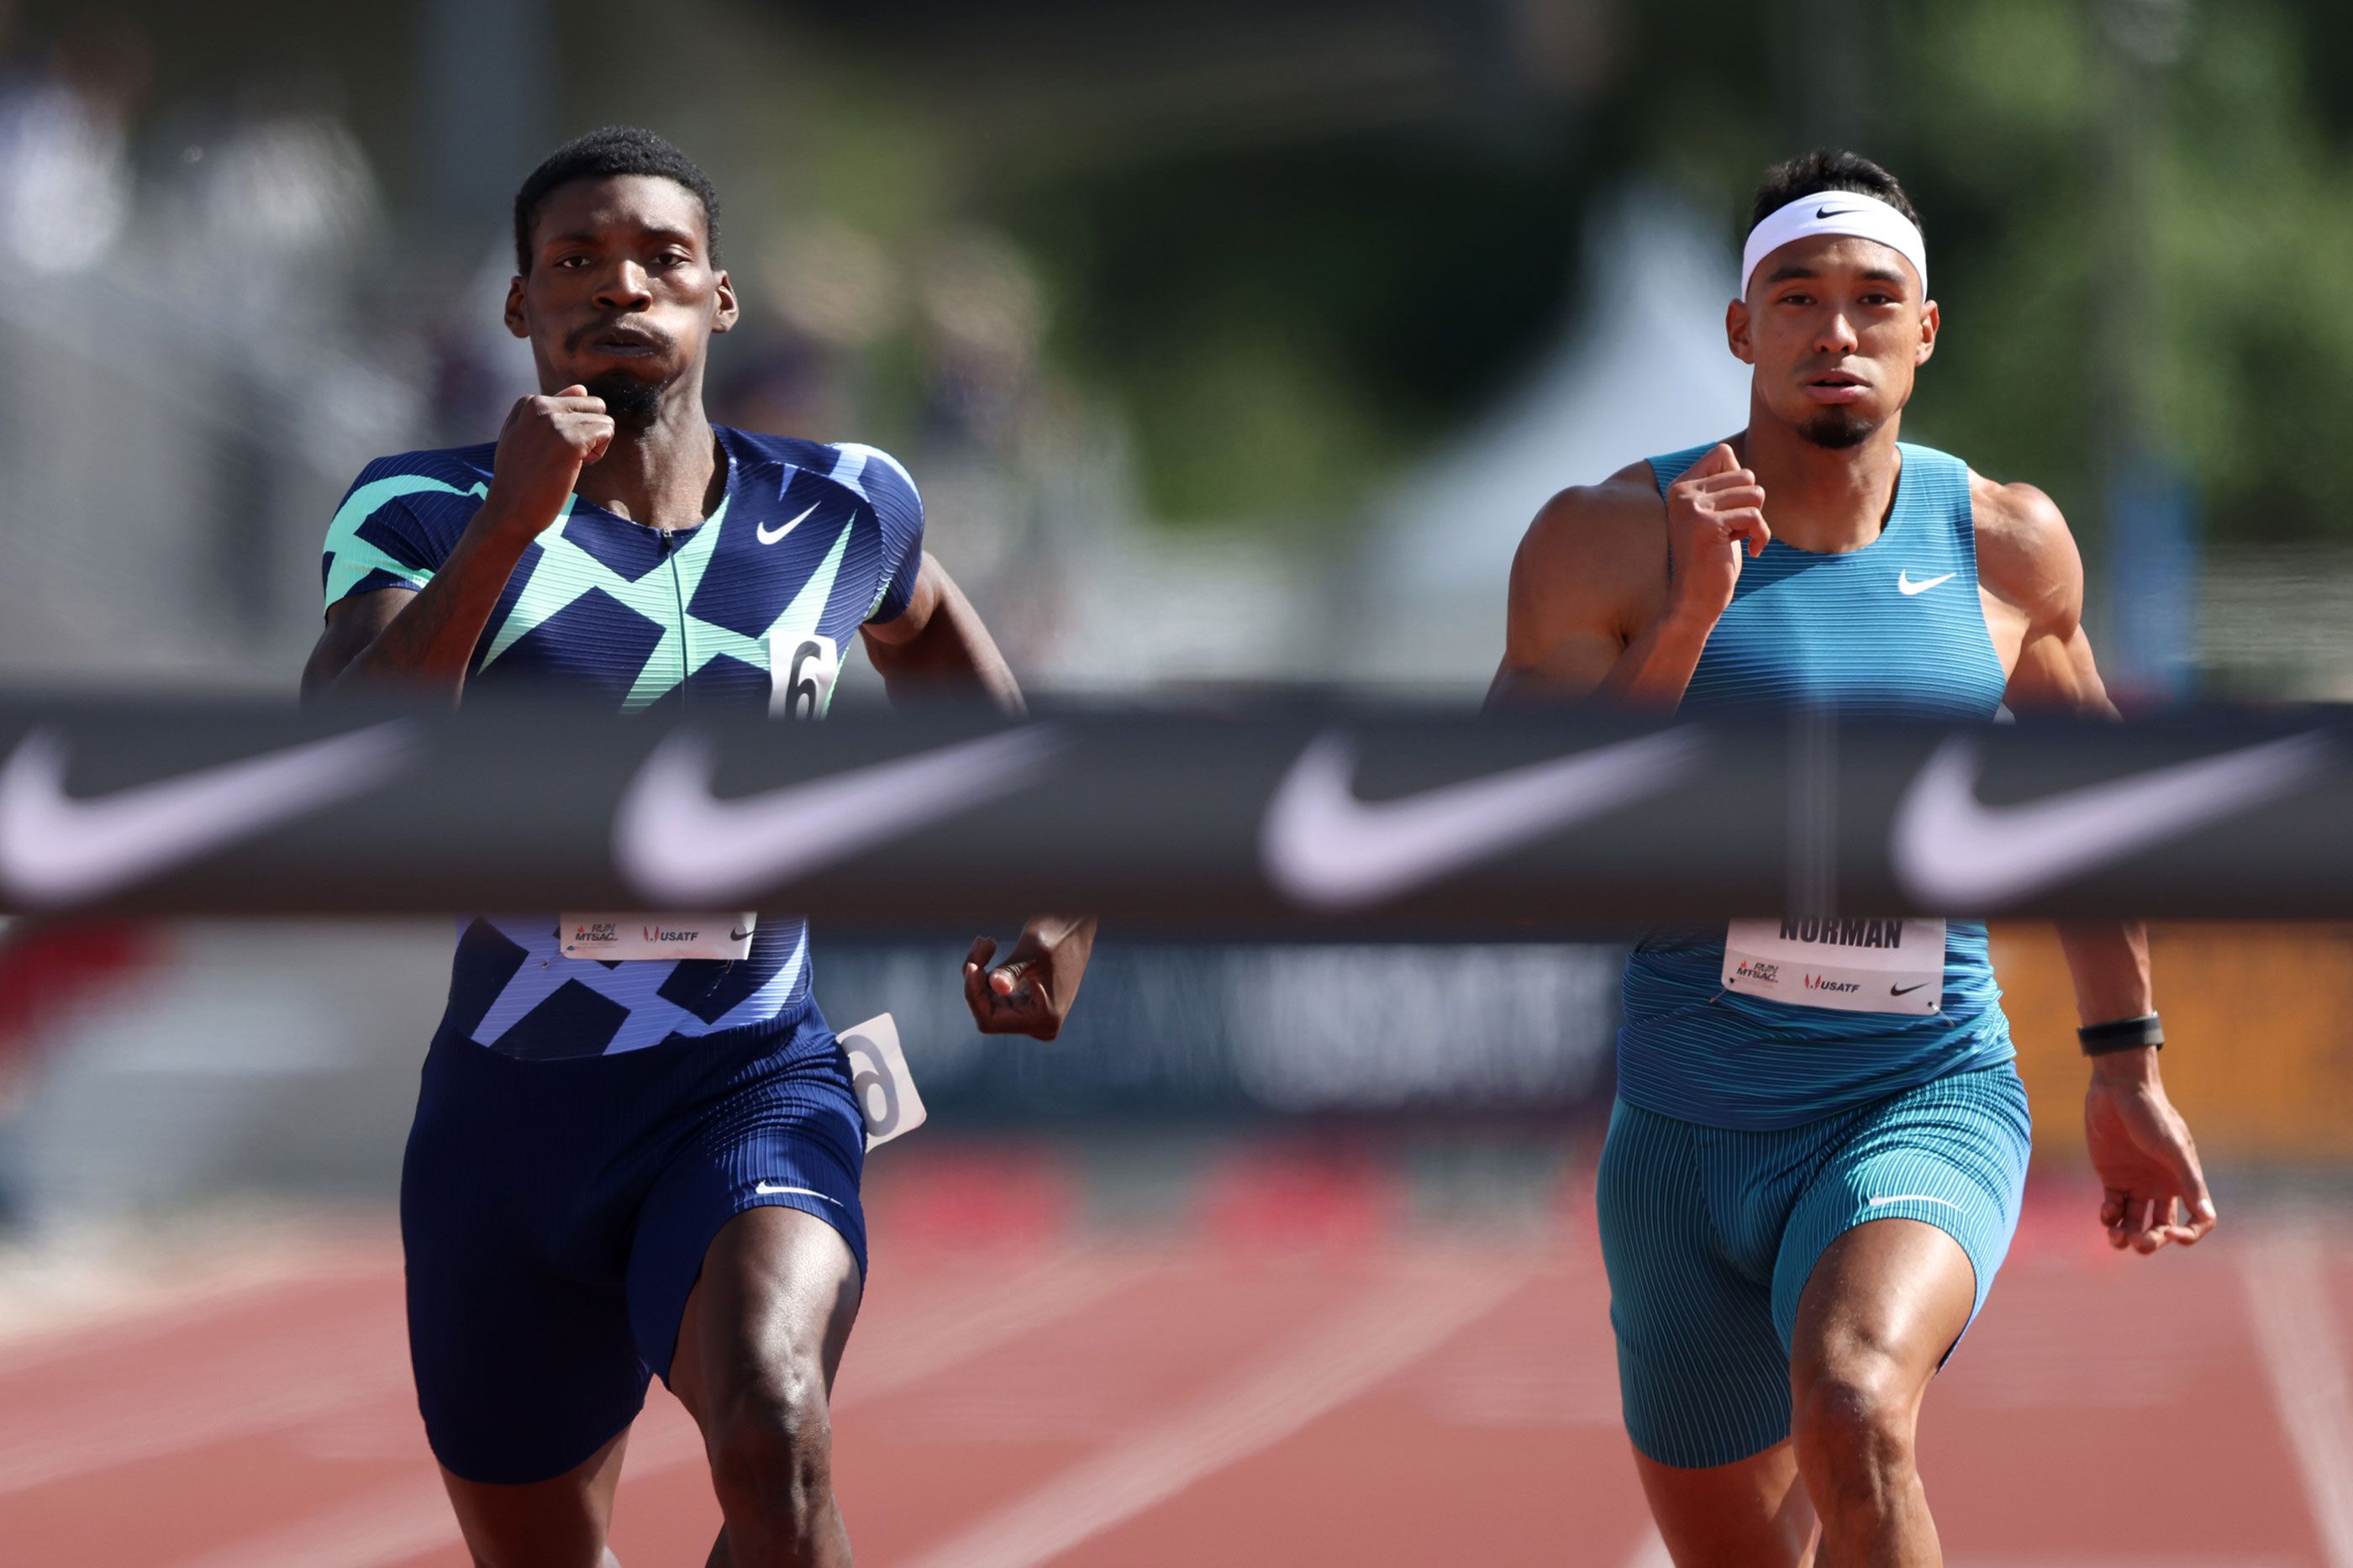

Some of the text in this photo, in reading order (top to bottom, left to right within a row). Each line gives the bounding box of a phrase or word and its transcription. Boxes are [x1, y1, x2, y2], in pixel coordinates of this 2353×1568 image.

[784, 640, 822, 718] 6
[660, 931, 699, 941] USATF
[1779, 918, 1903, 949] NORMAN
[1819, 981, 1861, 993] USATF
